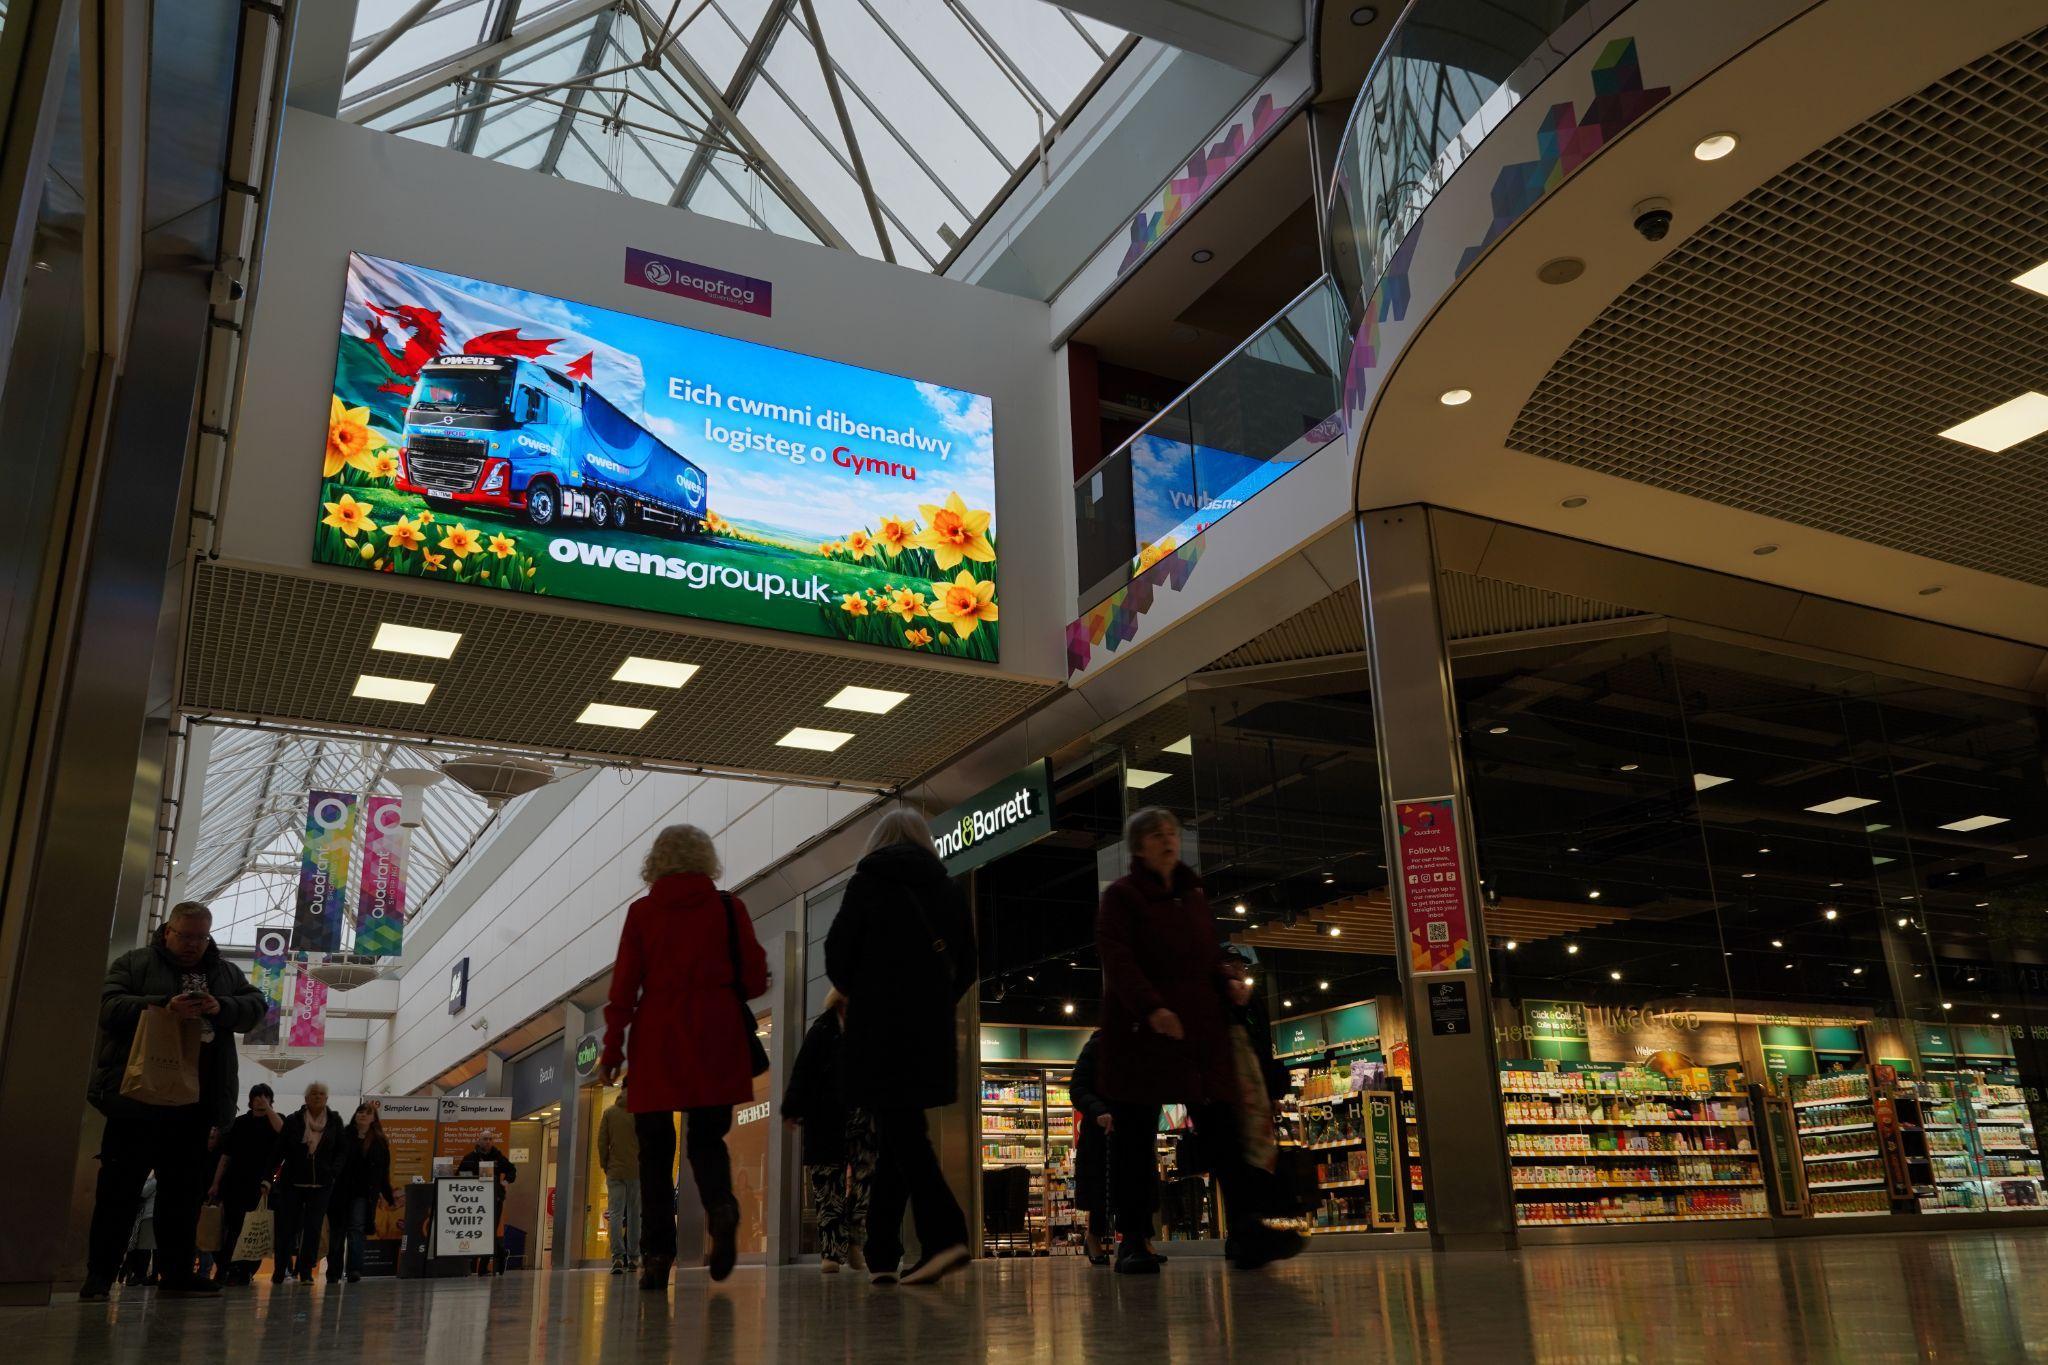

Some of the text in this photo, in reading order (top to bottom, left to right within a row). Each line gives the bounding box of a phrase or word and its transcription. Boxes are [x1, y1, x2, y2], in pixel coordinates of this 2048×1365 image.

[675, 270, 755, 303] leapfrog
[440, 357, 495, 365] owens
[669, 377, 951, 460] Eich cwmni dibenadwy
[705, 418, 917, 481] logisteg o Gymru
[548, 538, 831, 604] owensgroup.uk
[1408, 845, 1450, 855] Follow Us
[310, 846, 330, 915] Quadrant
[372, 850, 390, 919] Quadrant
[578, 1042, 597, 1066] schuh
[384, 1104, 413, 1112] Simpler
[460, 1105, 487, 1113] Simpler
[448, 1183, 484, 1192] Have
[453, 1194, 479, 1203] You
[446, 1205, 486, 1214] Got A
[448, 1216, 483, 1226] Will?
[456, 1230, 483, 1239] £49
